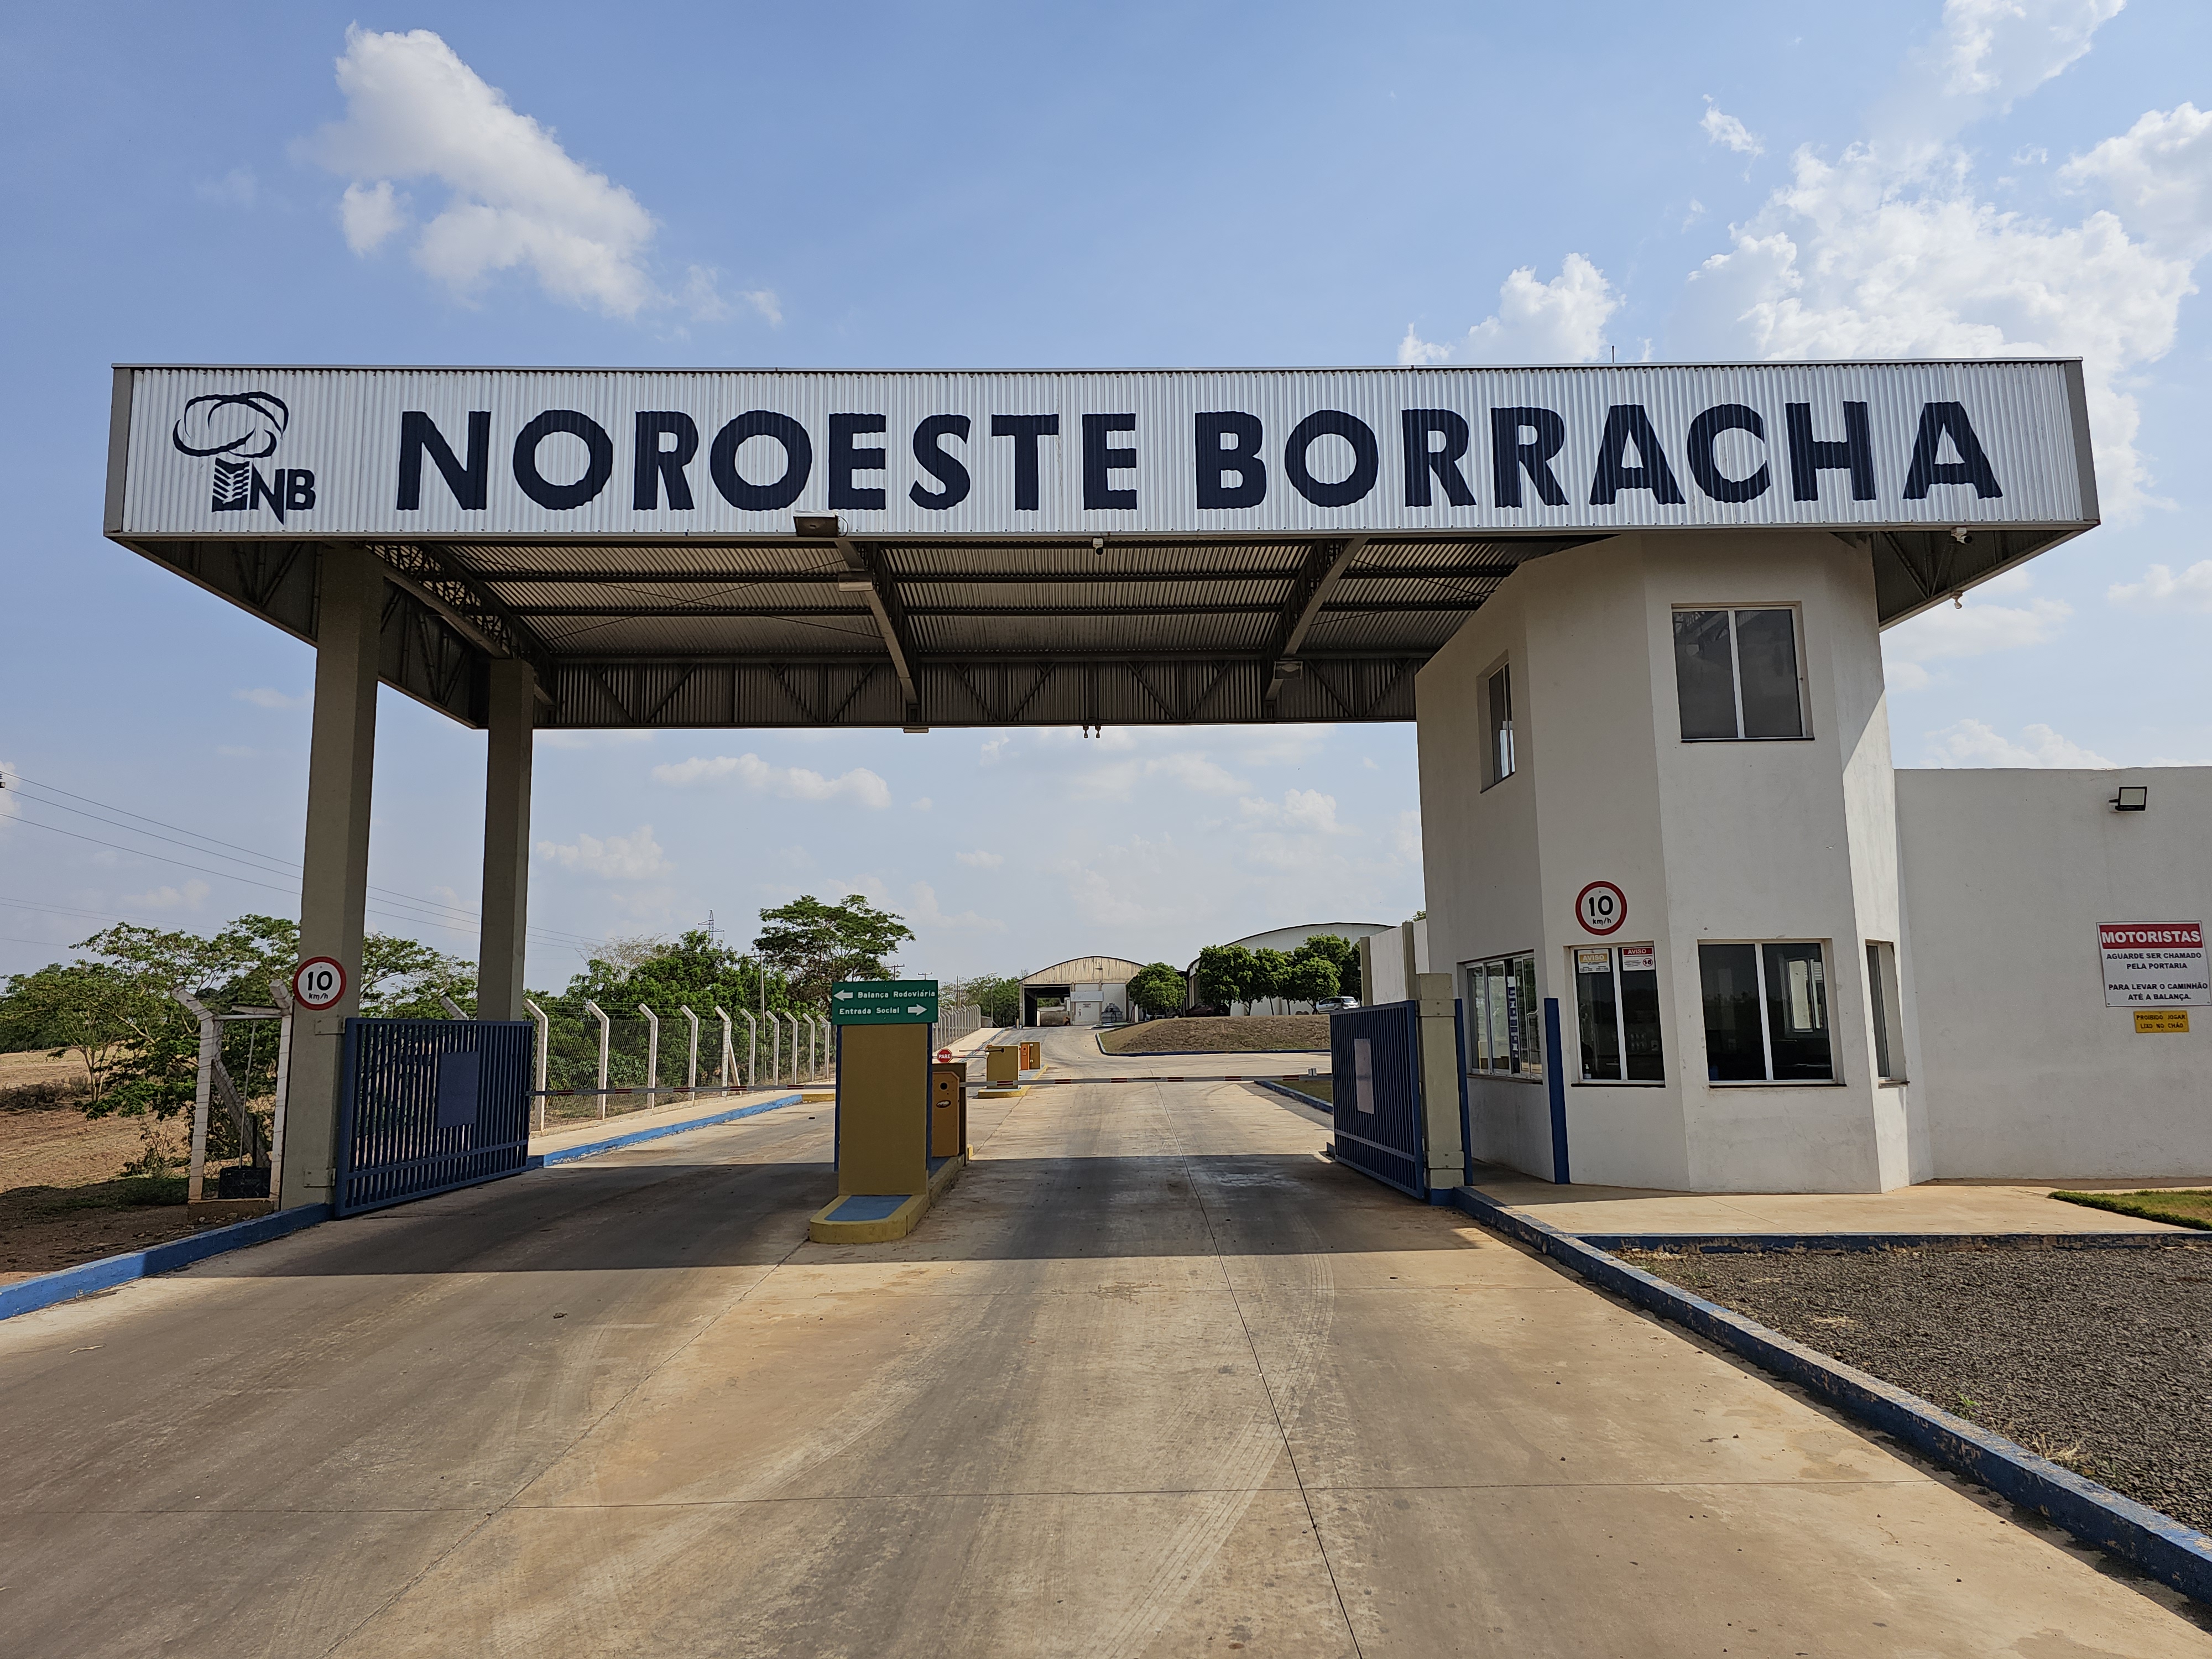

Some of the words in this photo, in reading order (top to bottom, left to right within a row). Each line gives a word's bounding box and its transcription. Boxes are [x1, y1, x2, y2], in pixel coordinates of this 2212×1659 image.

[397, 410, 1138, 512] NOROESTE
[1194, 400, 2004, 510] BORRACHA
[1589, 895, 1613, 916] 10
[2101, 931, 2201, 943] MOTORISTAS
[307, 971, 333, 991] 10
[893, 989, 935, 998] Rodoviária
